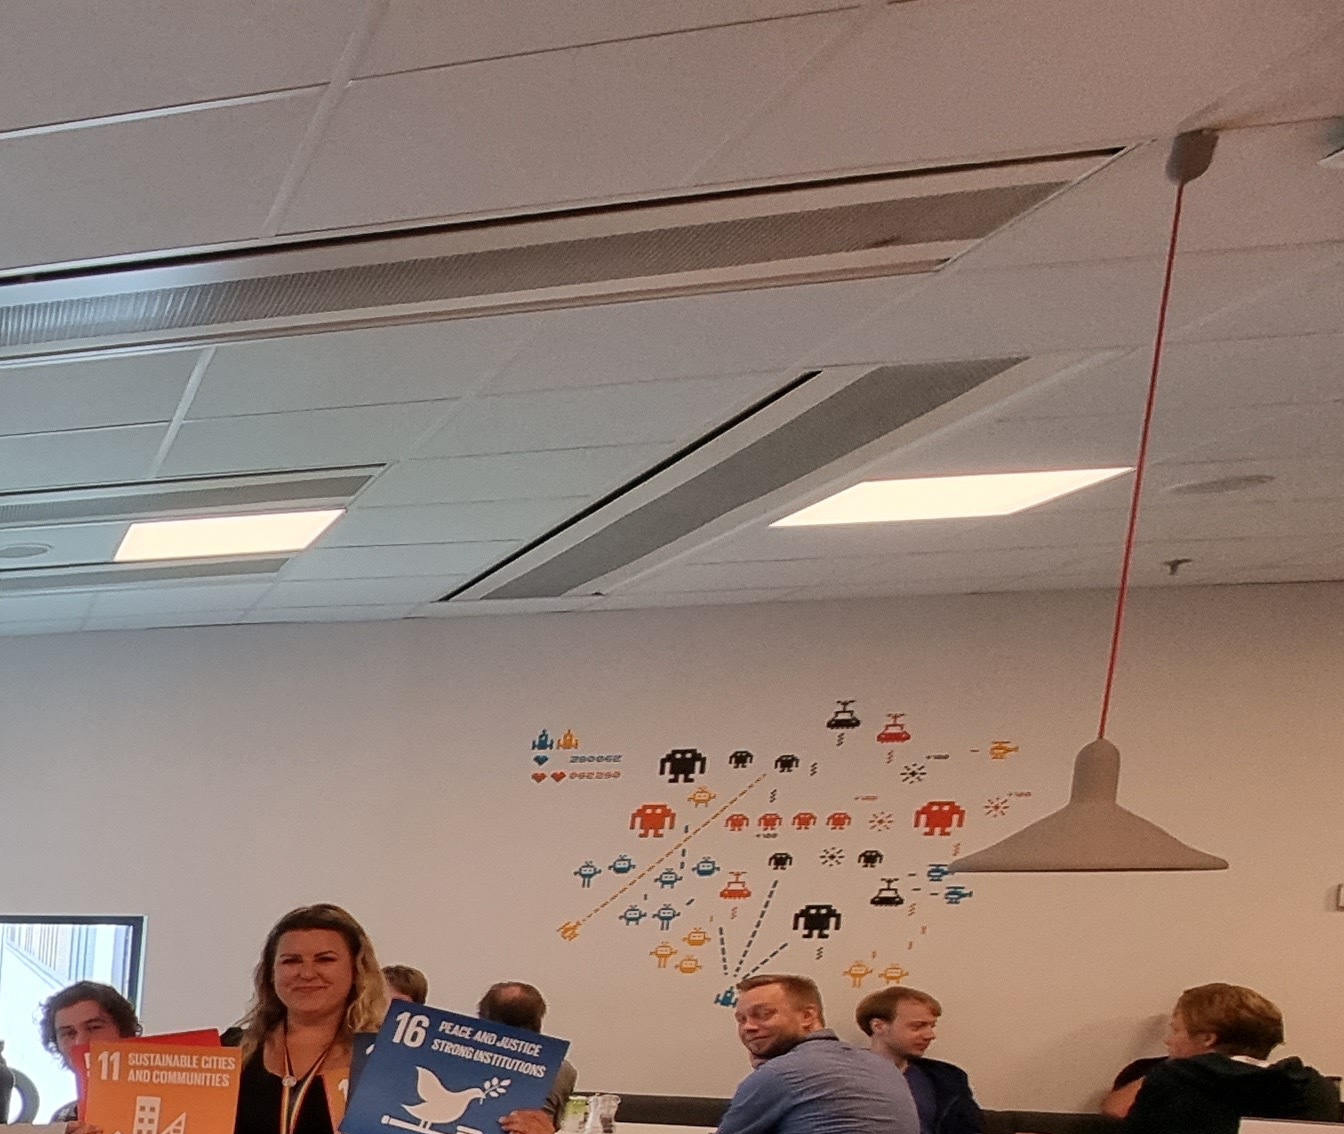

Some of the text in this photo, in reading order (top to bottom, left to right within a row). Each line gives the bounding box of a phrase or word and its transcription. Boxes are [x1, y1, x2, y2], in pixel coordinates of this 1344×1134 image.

[392, 1011, 430, 1048] 16
[438, 1020, 543, 1058] PEACE AND JUSTICE
[98, 1050, 122, 1082] 11
[128, 1052, 236, 1070] SUSTAINABLE CITIES
[431, 1038, 547, 1079] STRONG INSTITUTIONS
[127, 1069, 231, 1088] AND COMMUNITIES
